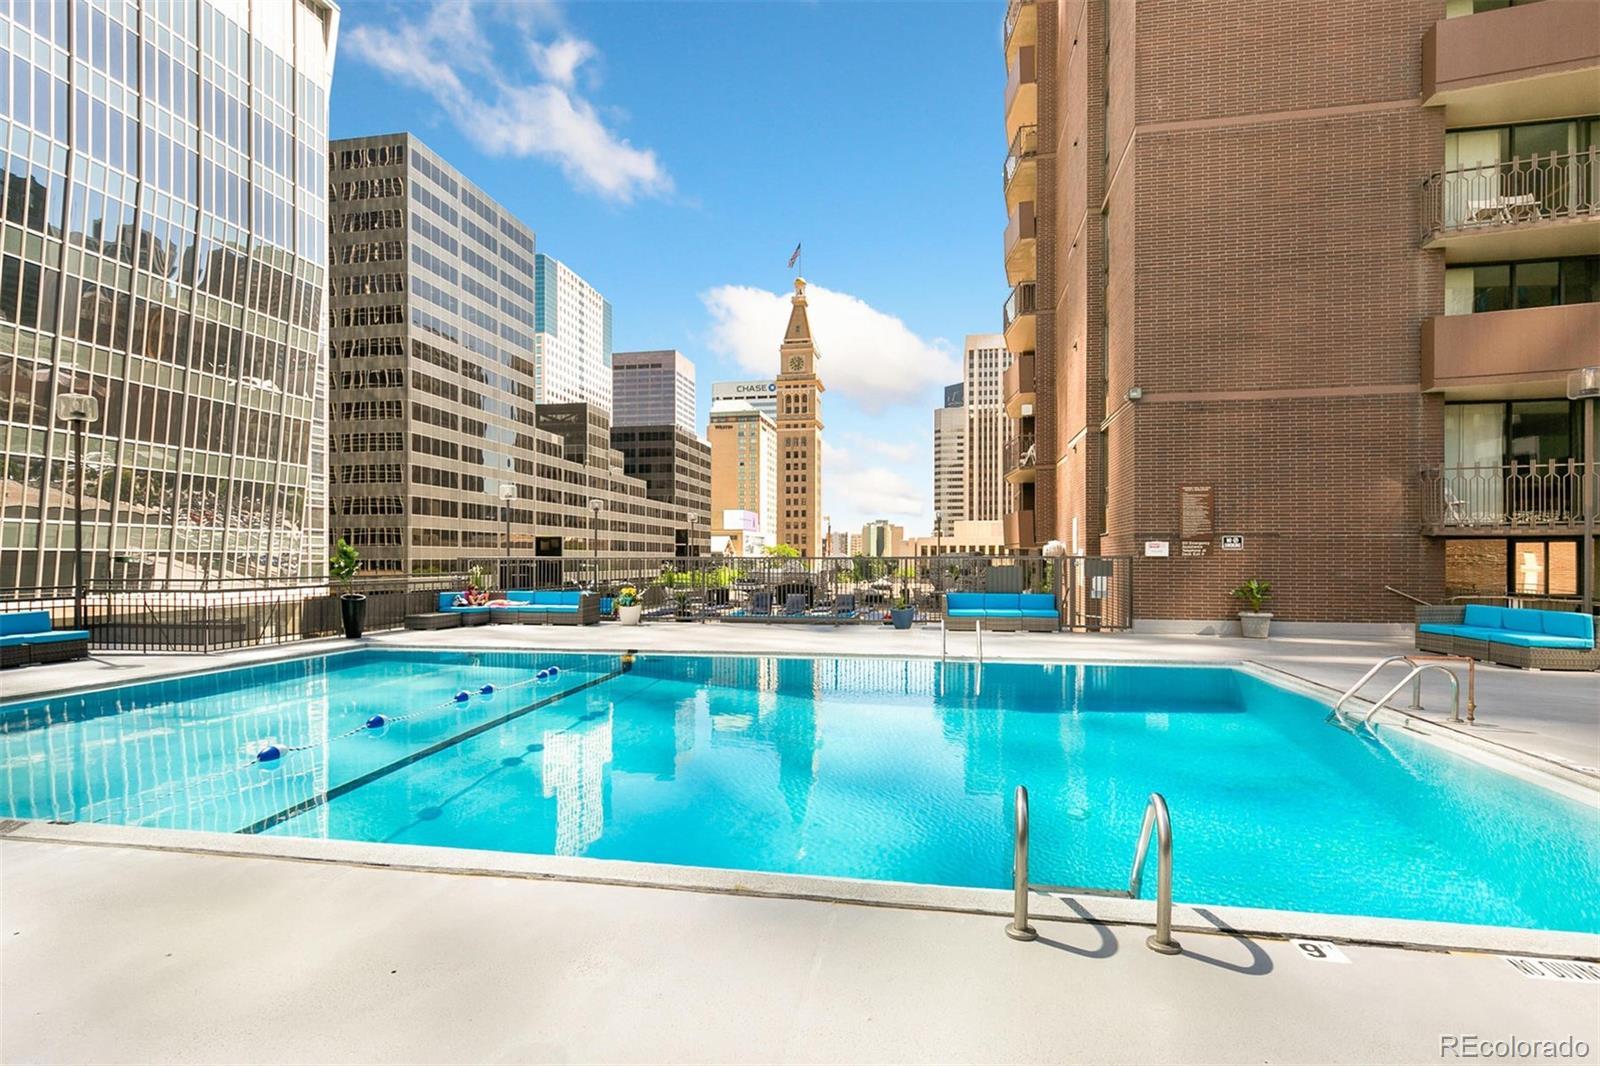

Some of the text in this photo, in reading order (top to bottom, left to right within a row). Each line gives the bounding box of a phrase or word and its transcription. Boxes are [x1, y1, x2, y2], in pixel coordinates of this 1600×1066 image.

[736, 384, 767, 392] CHASE
[1298, 944, 1327, 958] 9
[1506, 958, 1545, 976] NO
